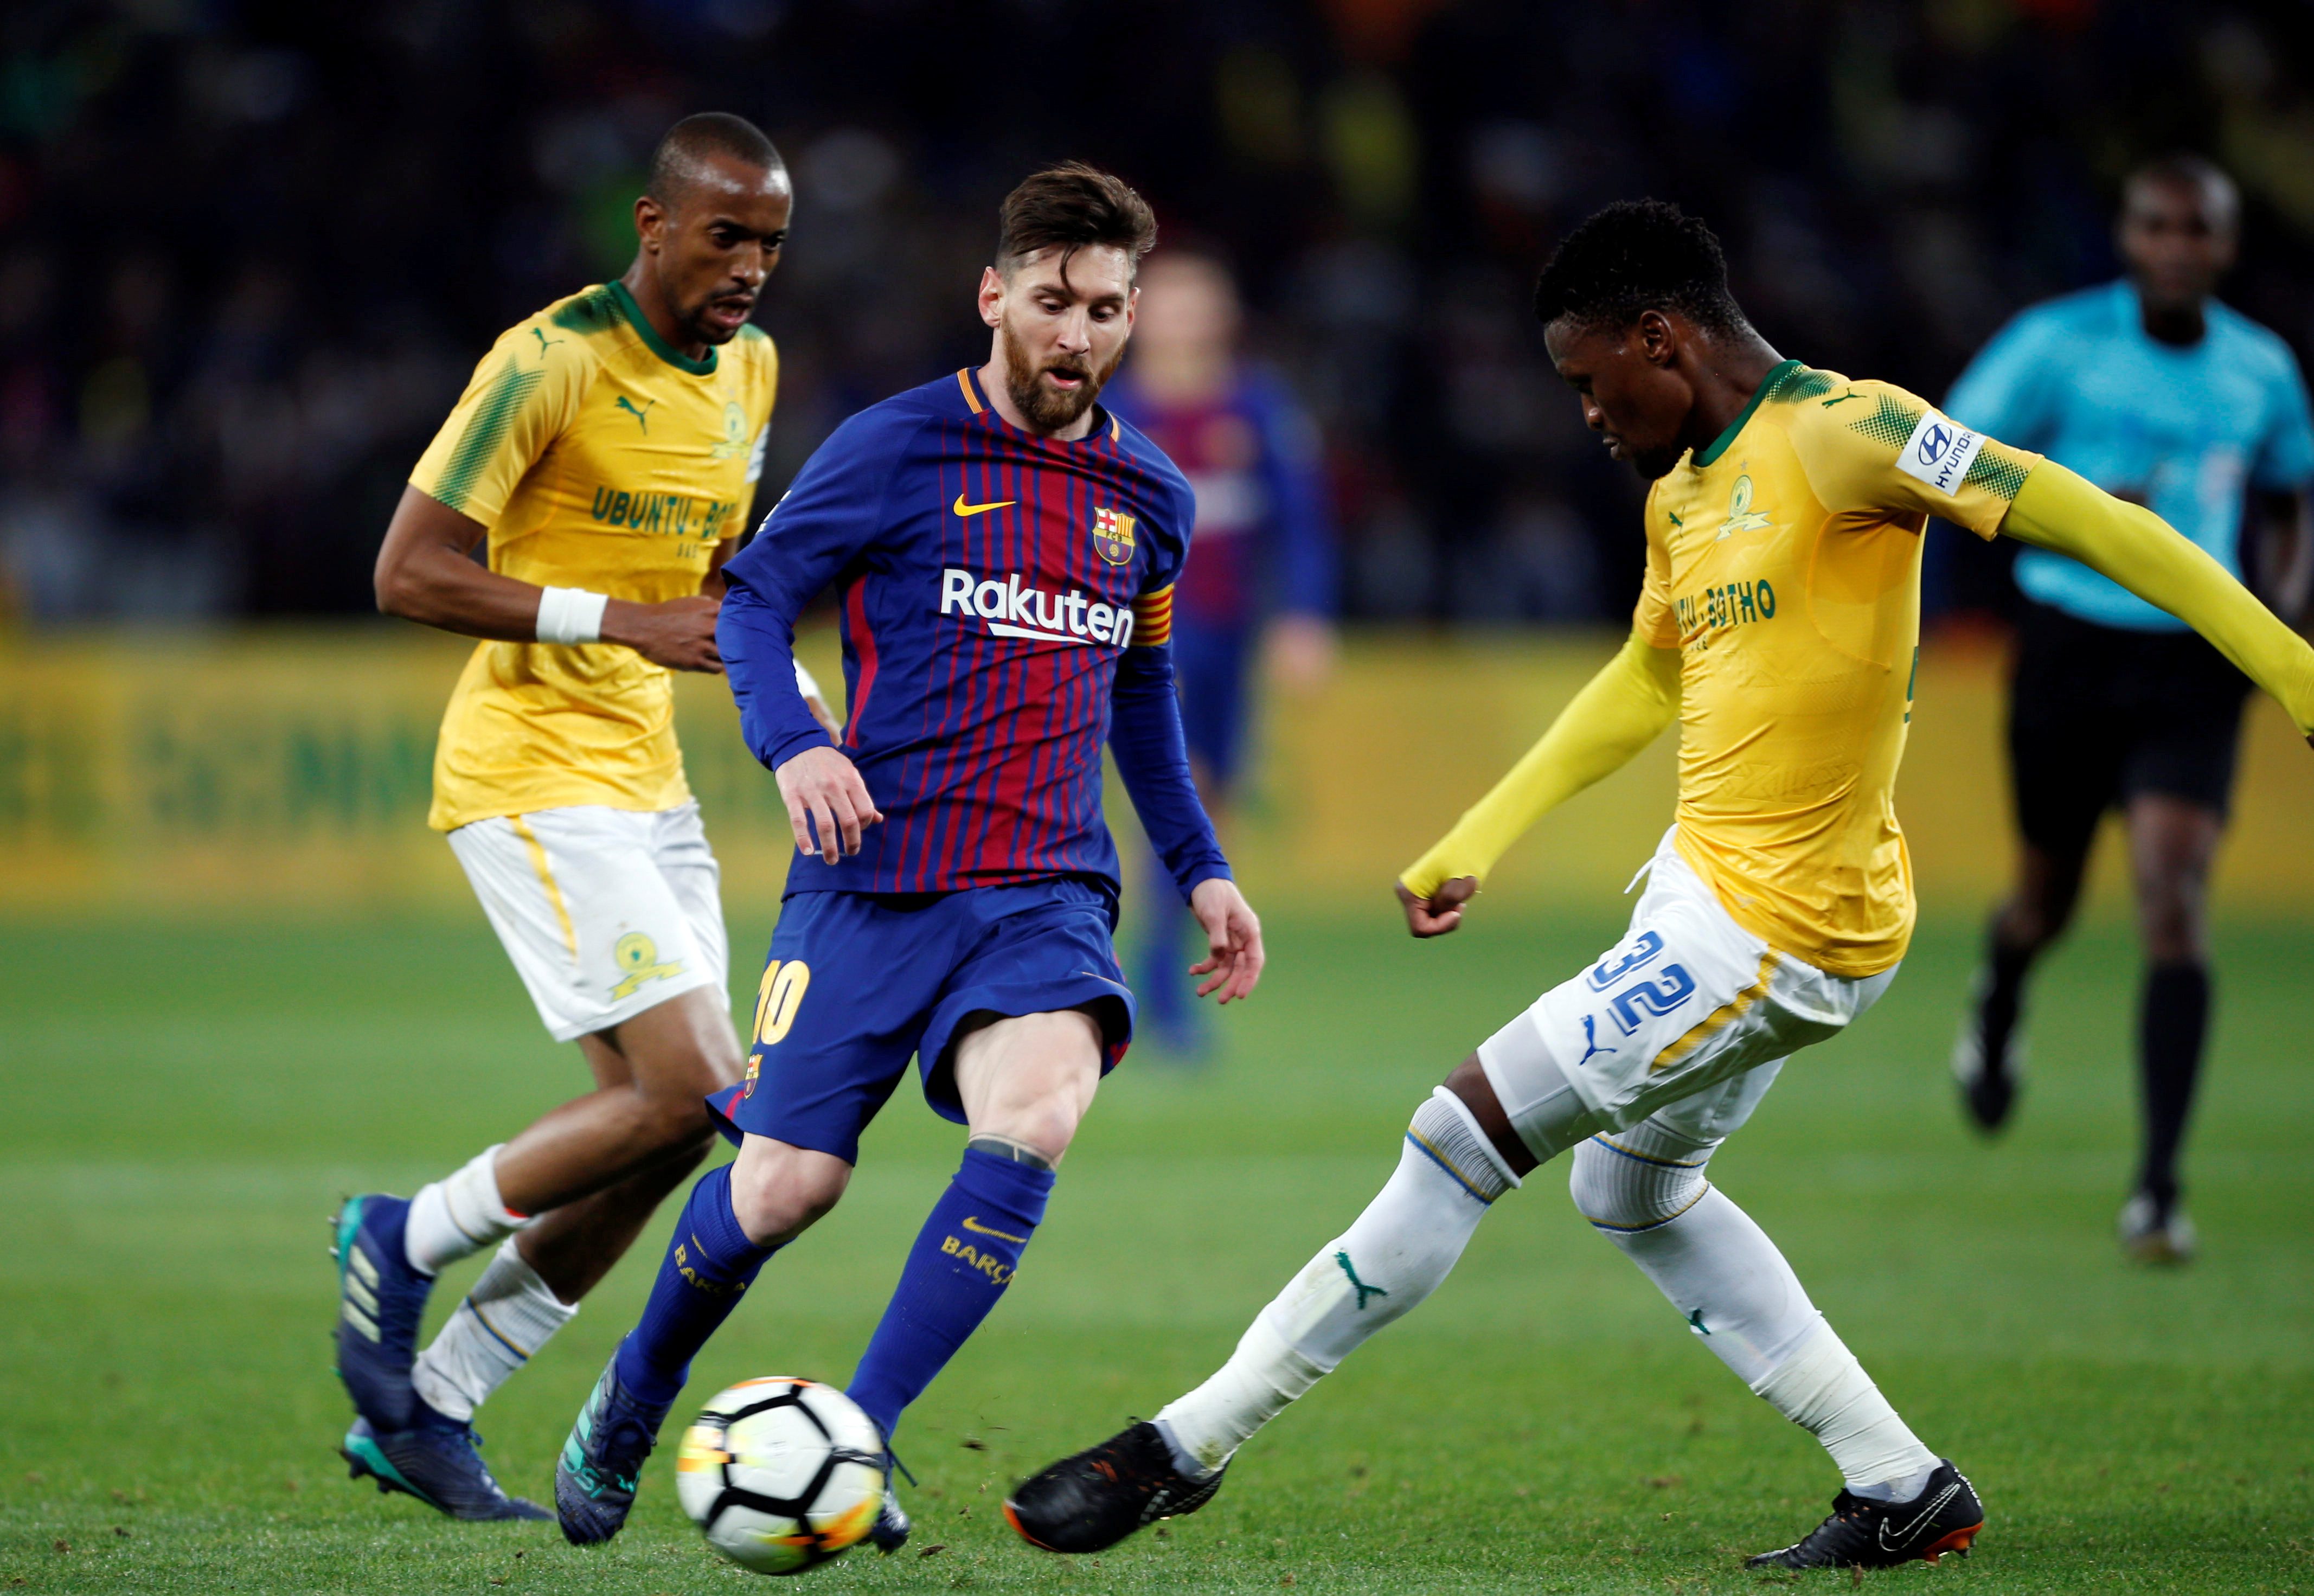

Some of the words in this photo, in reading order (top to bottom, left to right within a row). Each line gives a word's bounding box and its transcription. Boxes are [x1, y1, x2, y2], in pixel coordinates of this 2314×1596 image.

[1935, 431, 1976, 488] HYUNDAI
[940, 568, 1134, 648] Rakuten
[753, 959, 810, 1044] 10
[1587, 931, 1696, 1037] 32
